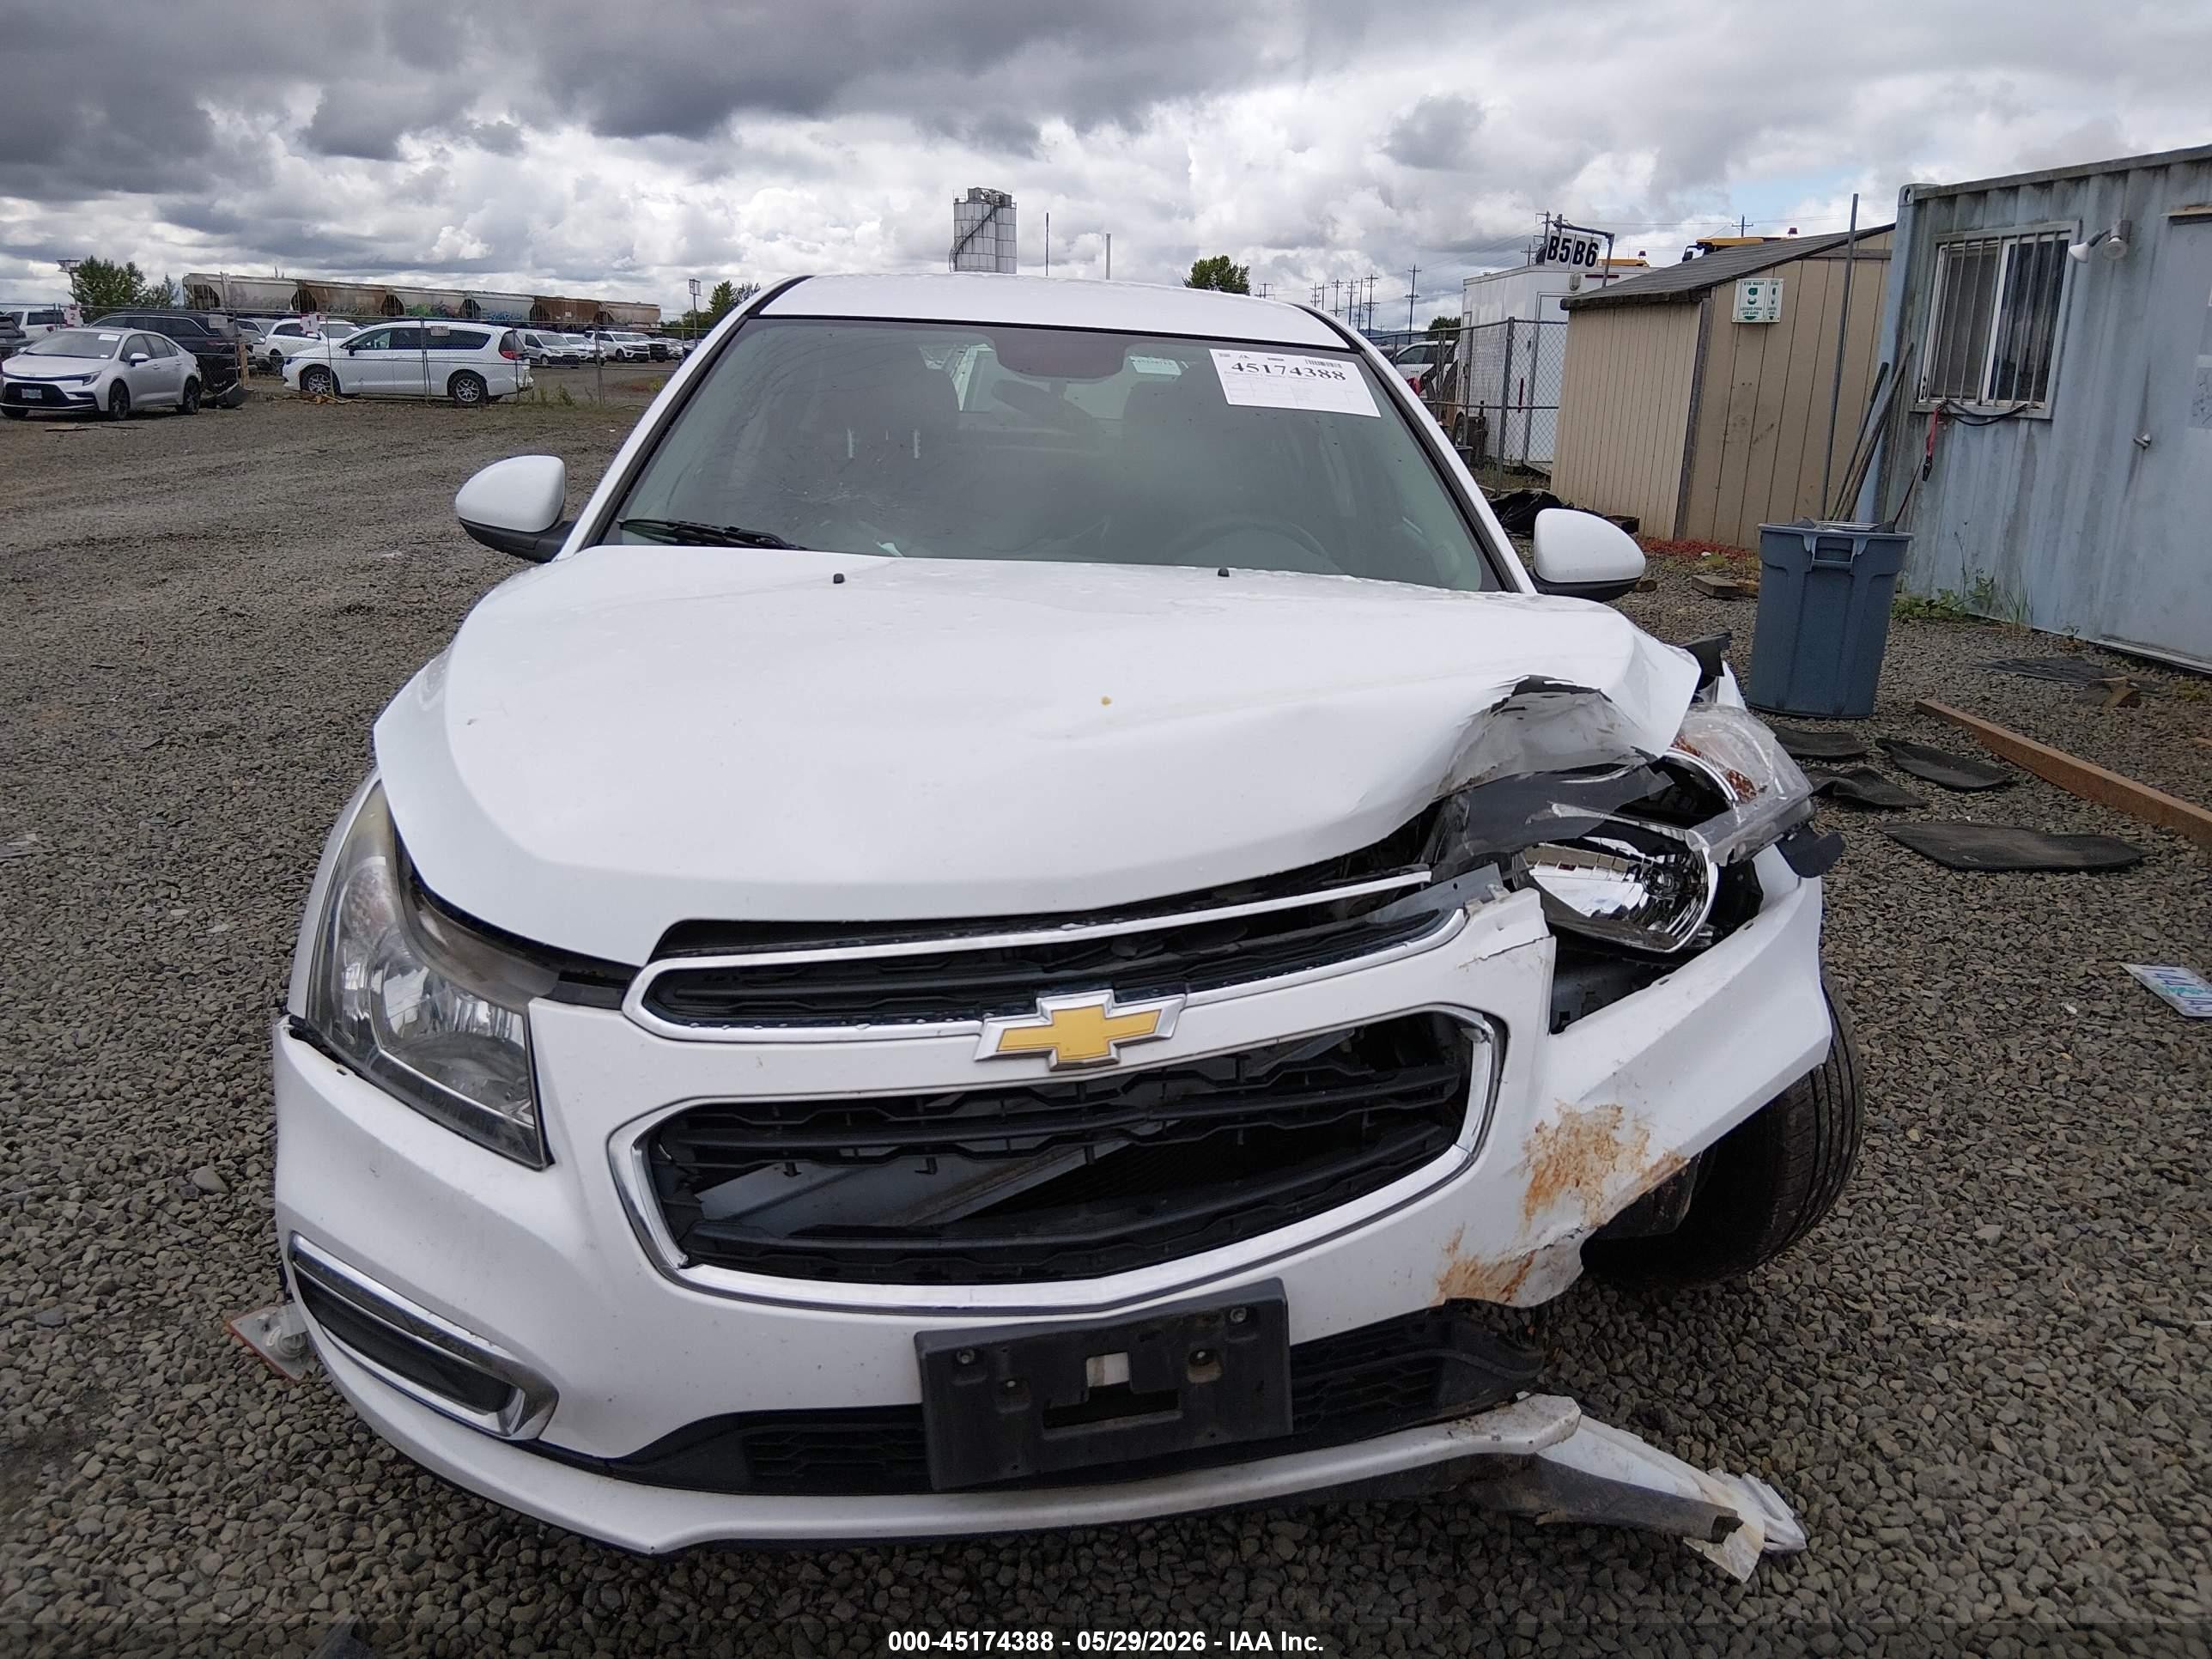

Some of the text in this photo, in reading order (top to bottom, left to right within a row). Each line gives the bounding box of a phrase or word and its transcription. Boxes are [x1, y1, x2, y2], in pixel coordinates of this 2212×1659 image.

[1547, 235, 1599, 268] B5 B6
[1231, 362, 1346, 381] 45174388
